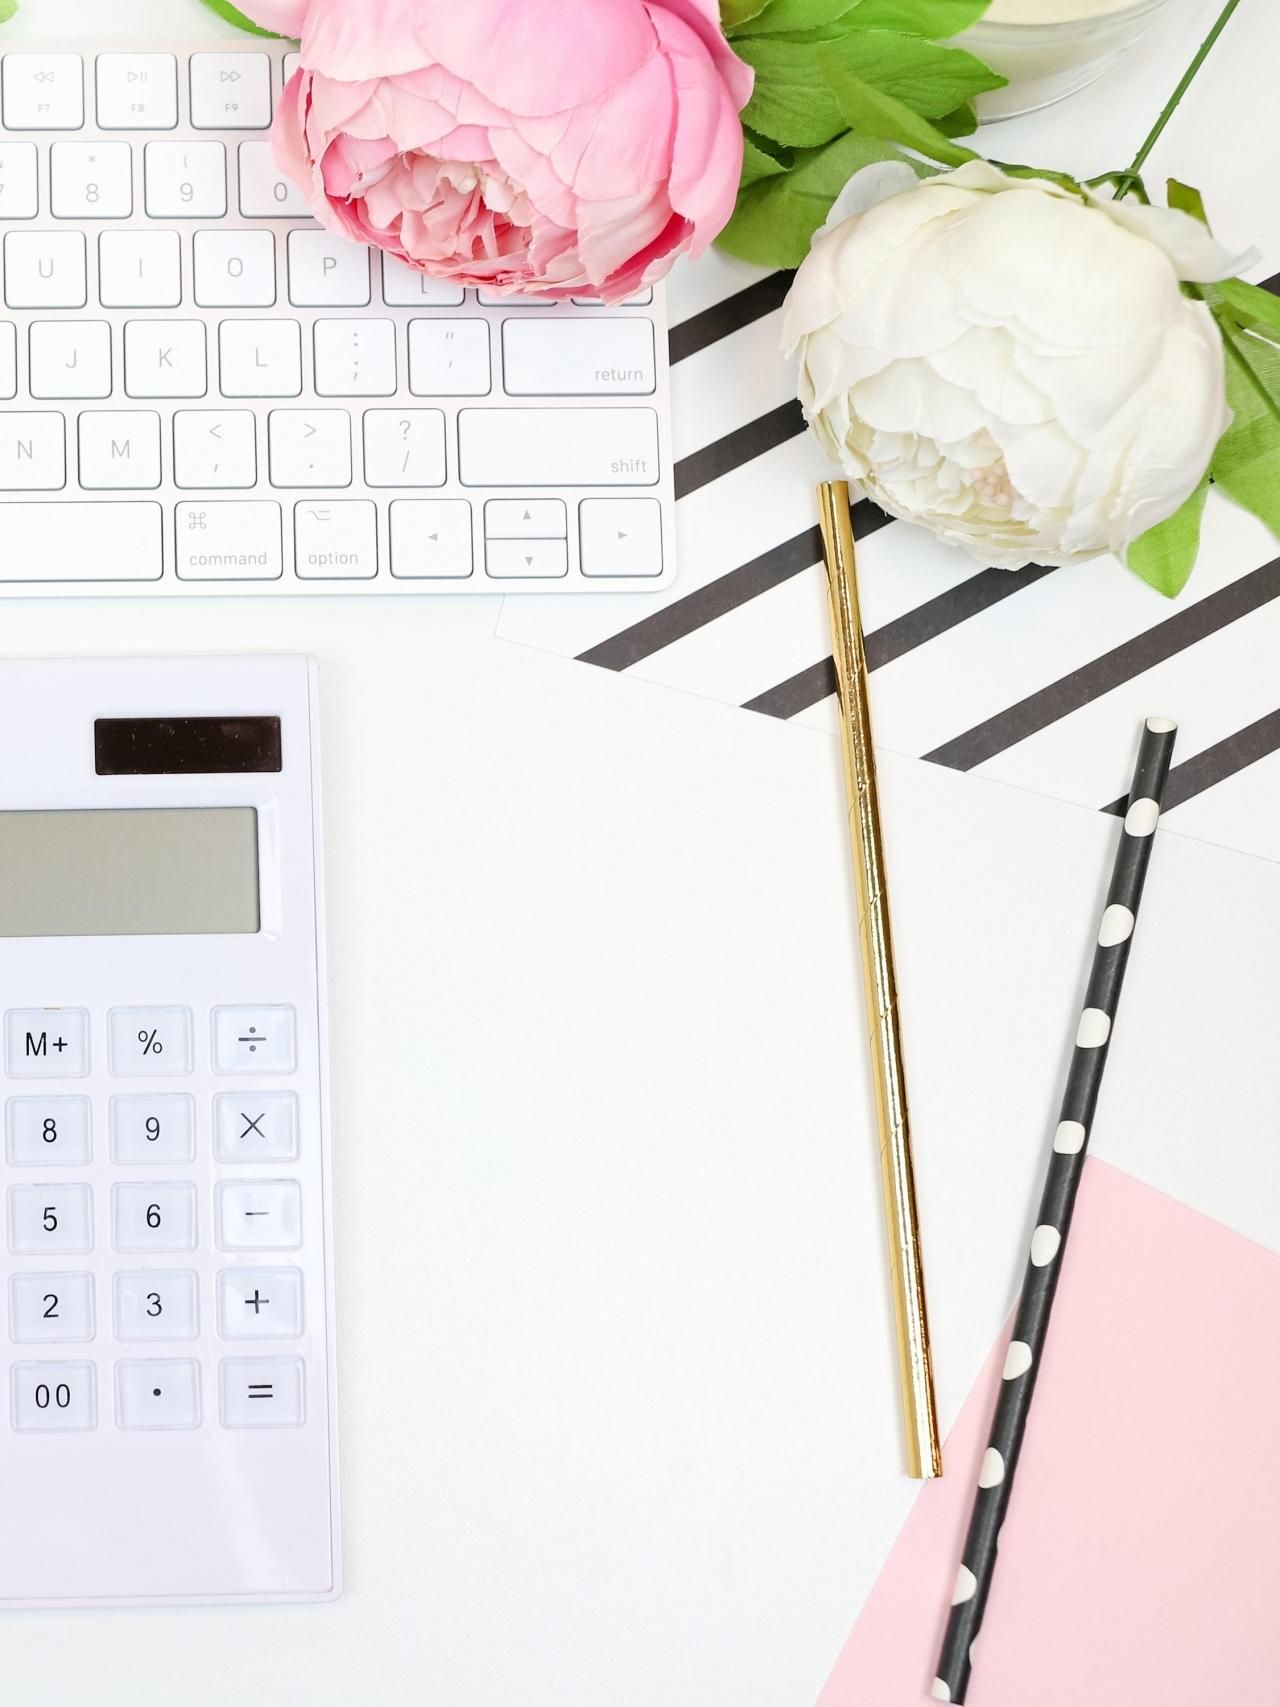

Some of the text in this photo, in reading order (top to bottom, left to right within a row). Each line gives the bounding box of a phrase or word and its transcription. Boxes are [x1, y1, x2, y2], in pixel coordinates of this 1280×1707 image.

[37, 103, 51, 113] F7
[130, 103, 145, 113] F8
[224, 102, 239, 113] F9
[85, 182, 100, 203] 8
[179, 181, 194, 203] 9
[273, 181, 289, 203] 0
[38, 258, 54, 279] U
[226, 256, 244, 278] O
[322, 256, 338, 277] P
[65, 348, 78, 369] J
[158, 347, 173, 368] K
[255, 347, 268, 368] L
[595, 368, 643, 382] return
[399, 419, 412, 441] ?
[17, 439, 33, 460] N
[111, 439, 131, 459] M
[610, 458, 647, 474] shift
[189, 551, 267, 566] command
[308, 552, 359, 568] option
[25, 1031, 69, 1057] M+
[137, 1028, 163, 1056] %
[42, 1117, 58, 1143] 8
[145, 1116, 160, 1142] 9
[43, 1206, 58, 1232] 5
[146, 1203, 161, 1229] 6
[42, 1293, 59, 1319] 2
[146, 1292, 163, 1317] 3
[35, 1383, 71, 1409] 00
